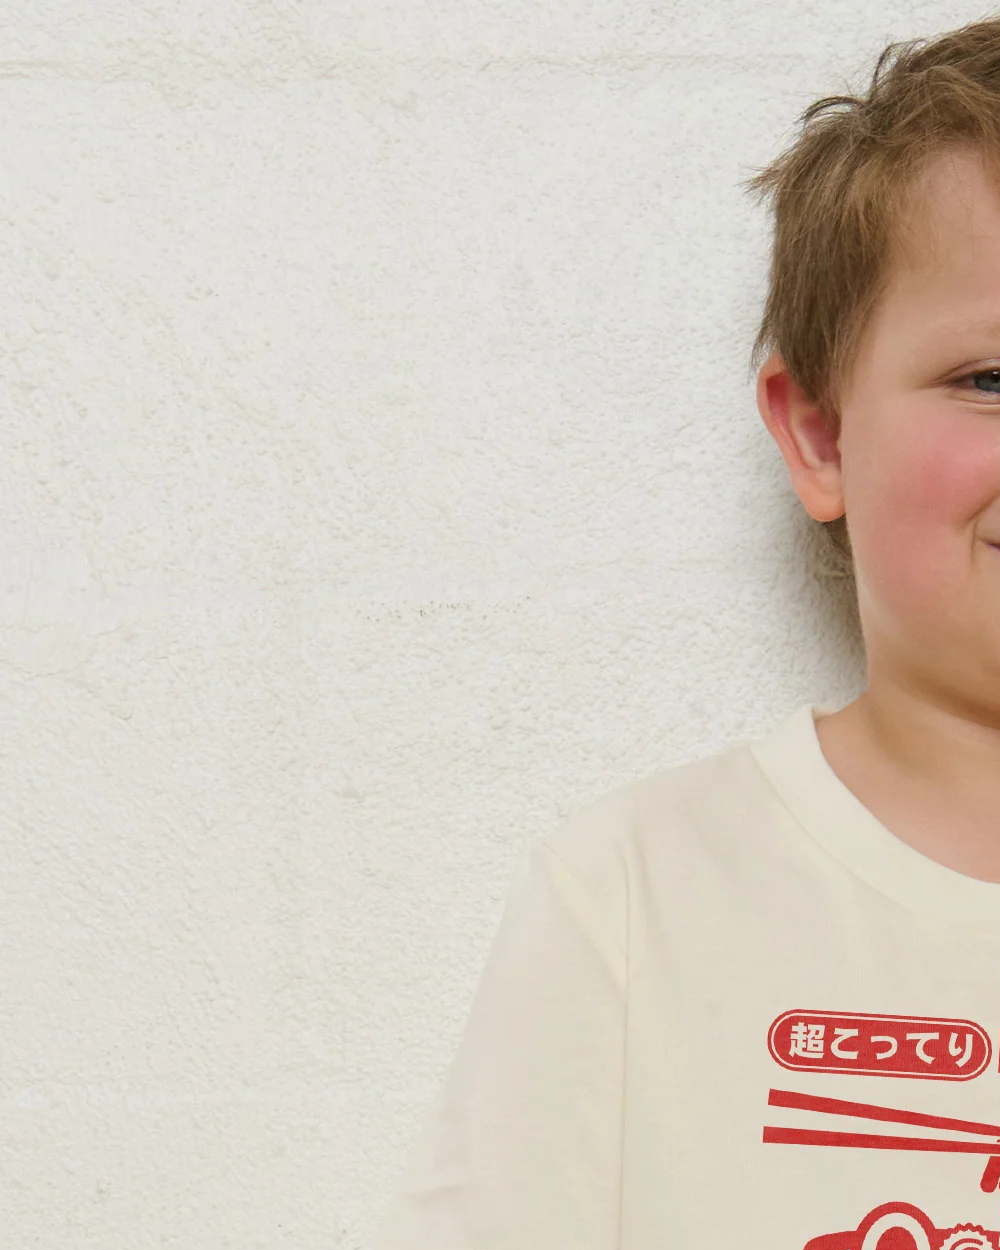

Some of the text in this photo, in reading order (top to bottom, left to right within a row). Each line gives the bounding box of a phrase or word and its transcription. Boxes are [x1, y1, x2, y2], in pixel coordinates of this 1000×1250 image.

[788, 1021, 974, 1068] 超こってり
